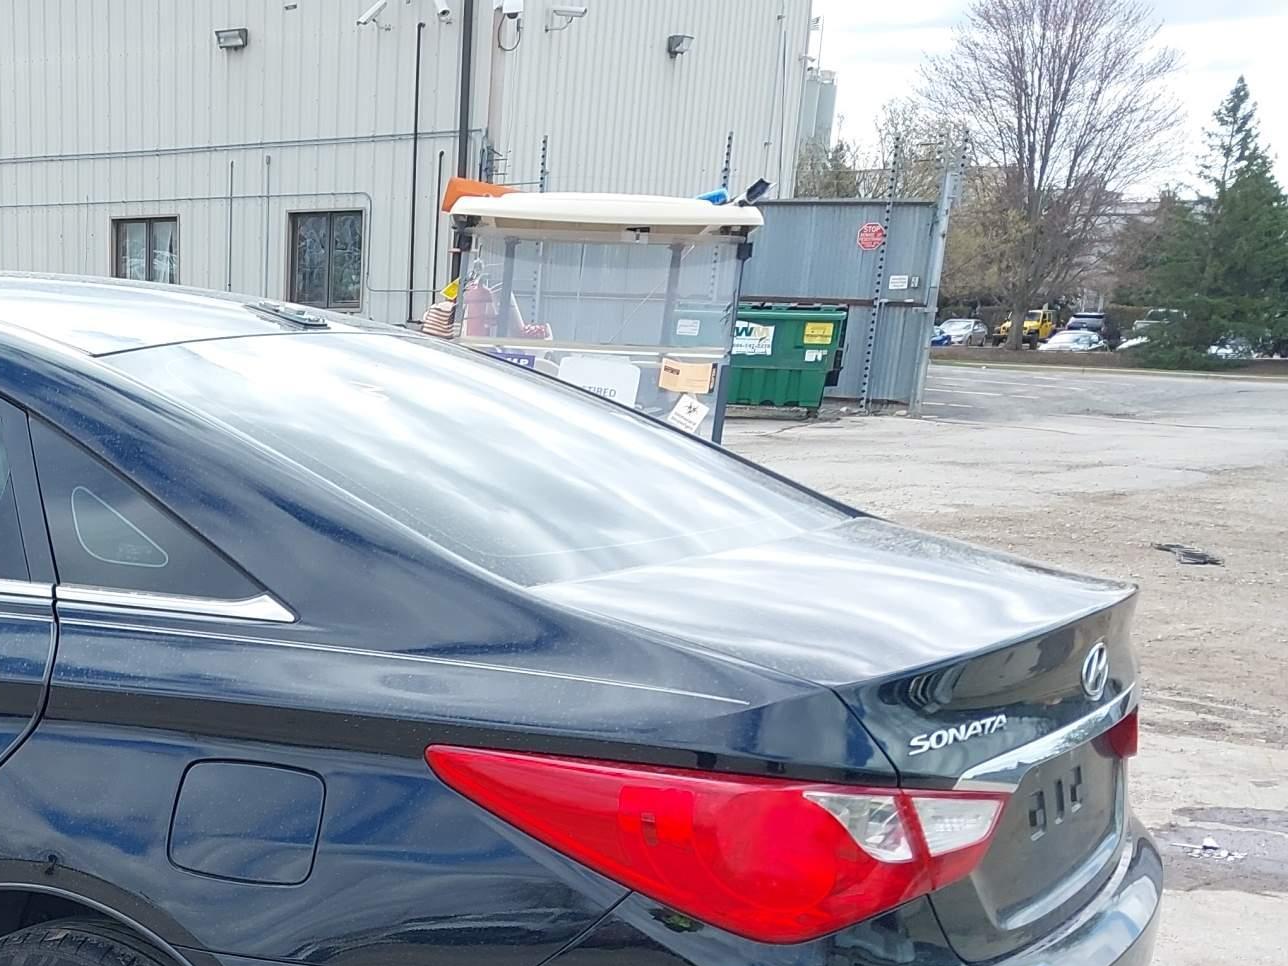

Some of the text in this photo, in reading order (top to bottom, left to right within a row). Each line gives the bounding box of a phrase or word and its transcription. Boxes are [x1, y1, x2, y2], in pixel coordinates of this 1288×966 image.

[863, 225, 881, 233] STOP
[734, 326, 770, 337] WM
[908, 714, 1008, 756] SONATA
